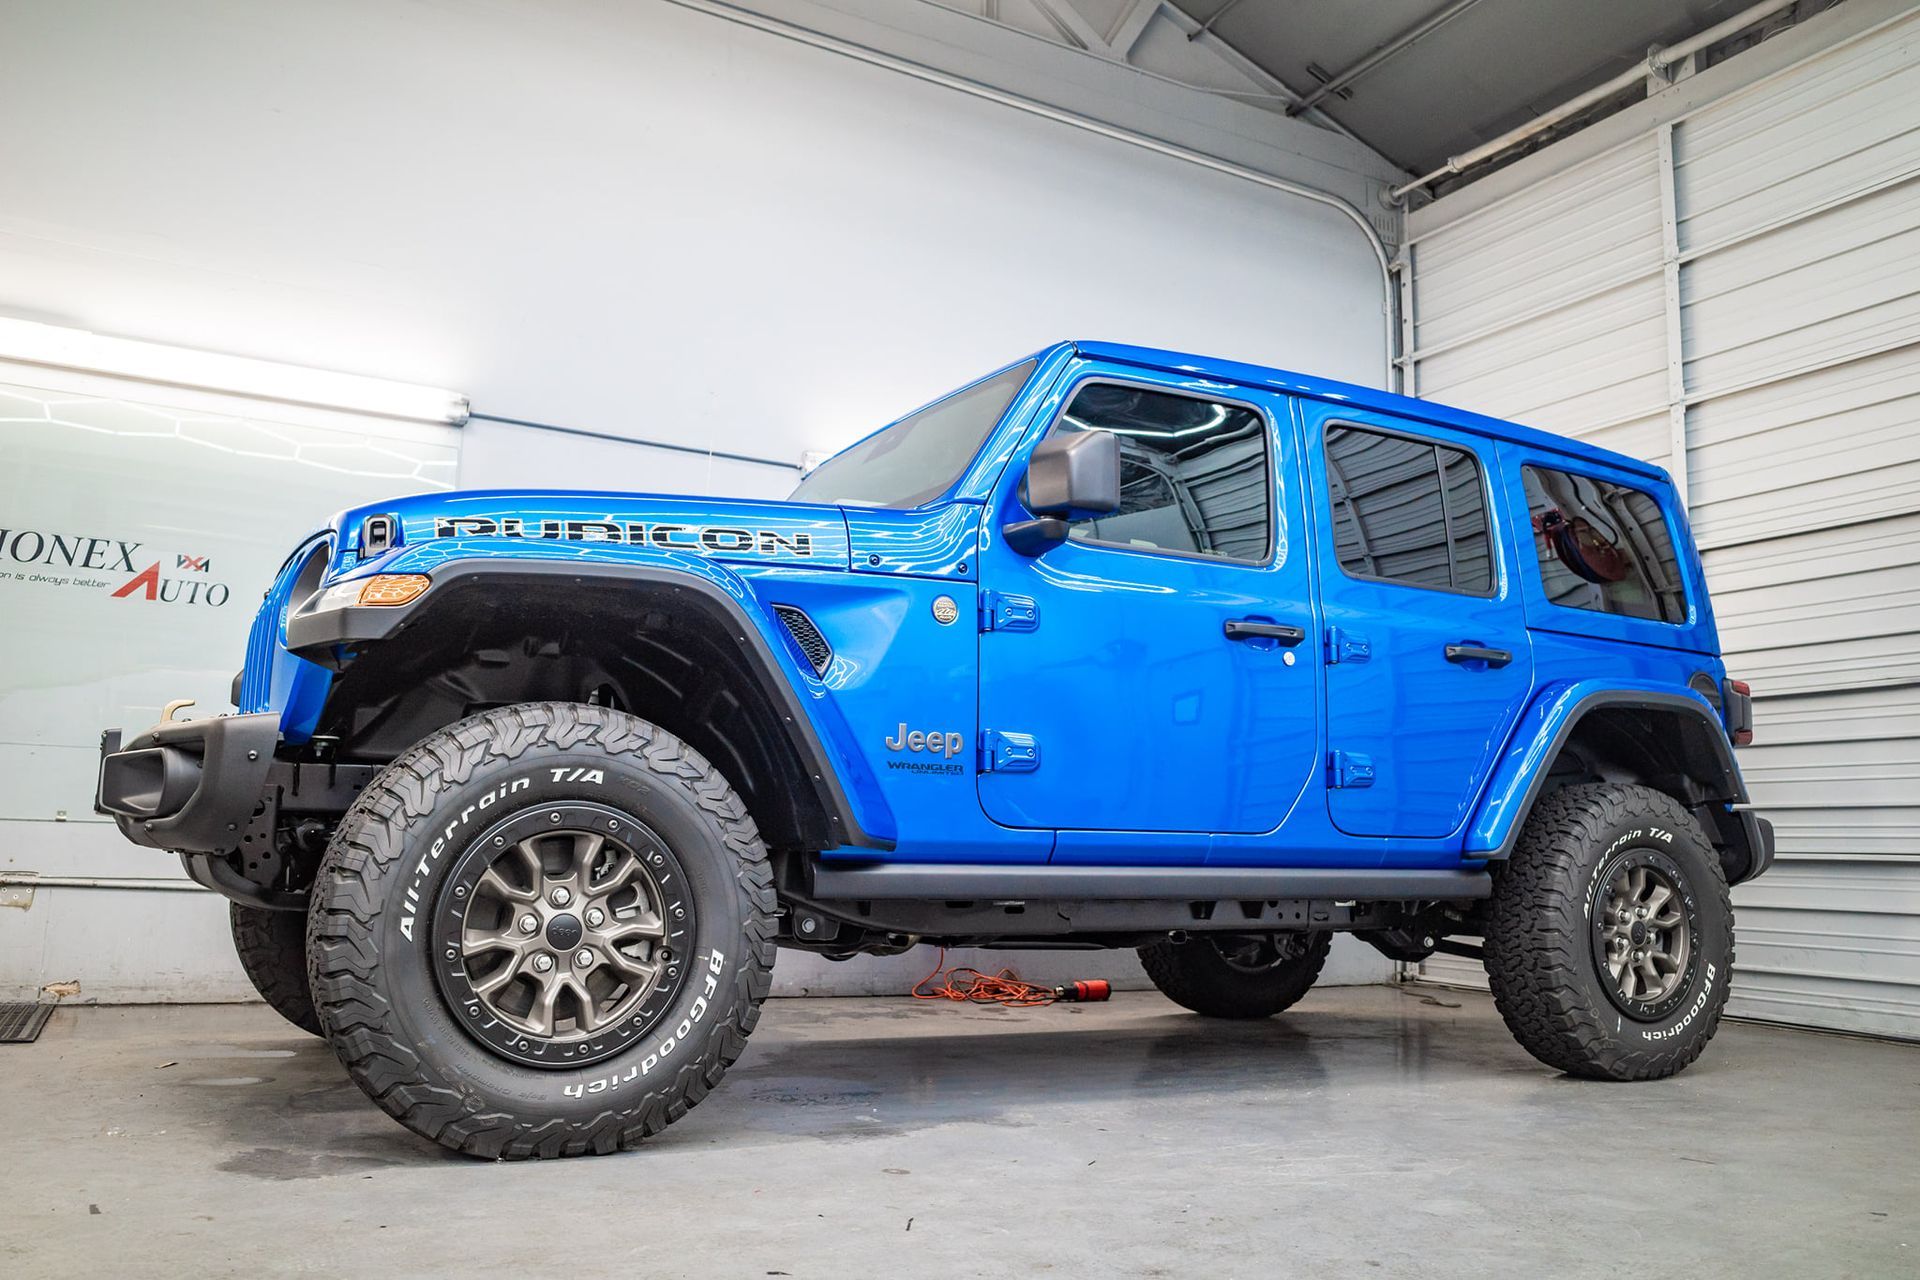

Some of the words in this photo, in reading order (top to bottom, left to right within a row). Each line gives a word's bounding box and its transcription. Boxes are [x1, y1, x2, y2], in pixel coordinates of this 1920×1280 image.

[433, 516, 813, 557] RUBICON
[15, 572, 25, 580] is
[29, 573, 69, 586] always
[73, 577, 111, 588] better
[885, 722, 964, 760] Jeep
[887, 760, 964, 772] WRANGLER
[400, 775, 530, 943] All-Terrain
[549, 766, 605, 786] T/A
[1583, 828, 1642, 920] All-Terrain
[1649, 827, 1674, 844] T/A
[563, 948, 725, 1099] BFGoodrich
[1642, 962, 1717, 1042] BFGoodrich
